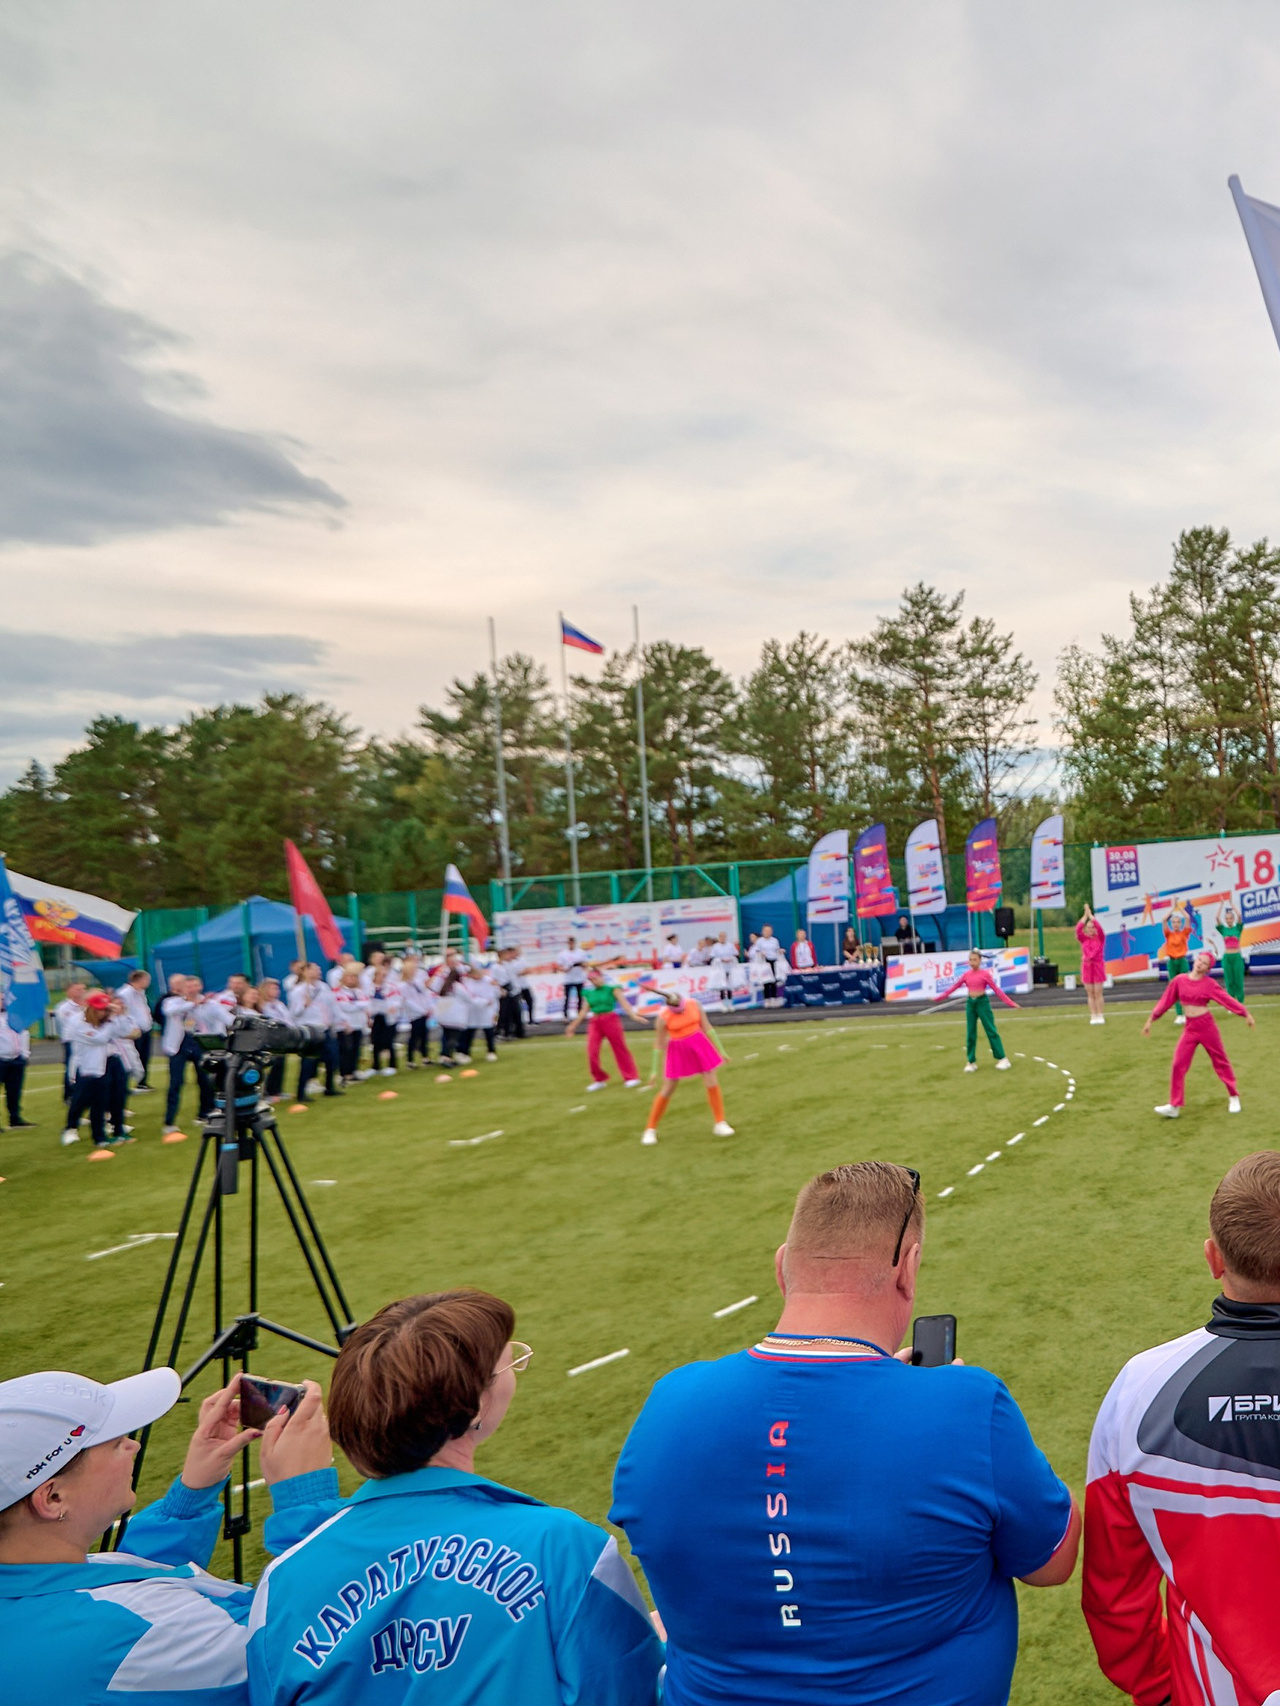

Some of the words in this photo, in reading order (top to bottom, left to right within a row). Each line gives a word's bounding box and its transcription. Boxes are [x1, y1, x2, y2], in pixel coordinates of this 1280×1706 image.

[1109, 850, 1136, 861] 30.08
[1110, 862, 1136, 871] 31.08
[1233, 849, 1275, 890] 18
[1110, 871, 1138, 883] 2024
[935, 962, 953, 978] 18
[1235, 1413, 1267, 1421] ГРУППА
[26, 1461, 47, 1480] rbk
[766, 1421, 801, 1627] RUSSIA
[293, 1534, 546, 1671] КАРАТУЗСКОЕ
[371, 1613, 473, 1676] ДРСУ
